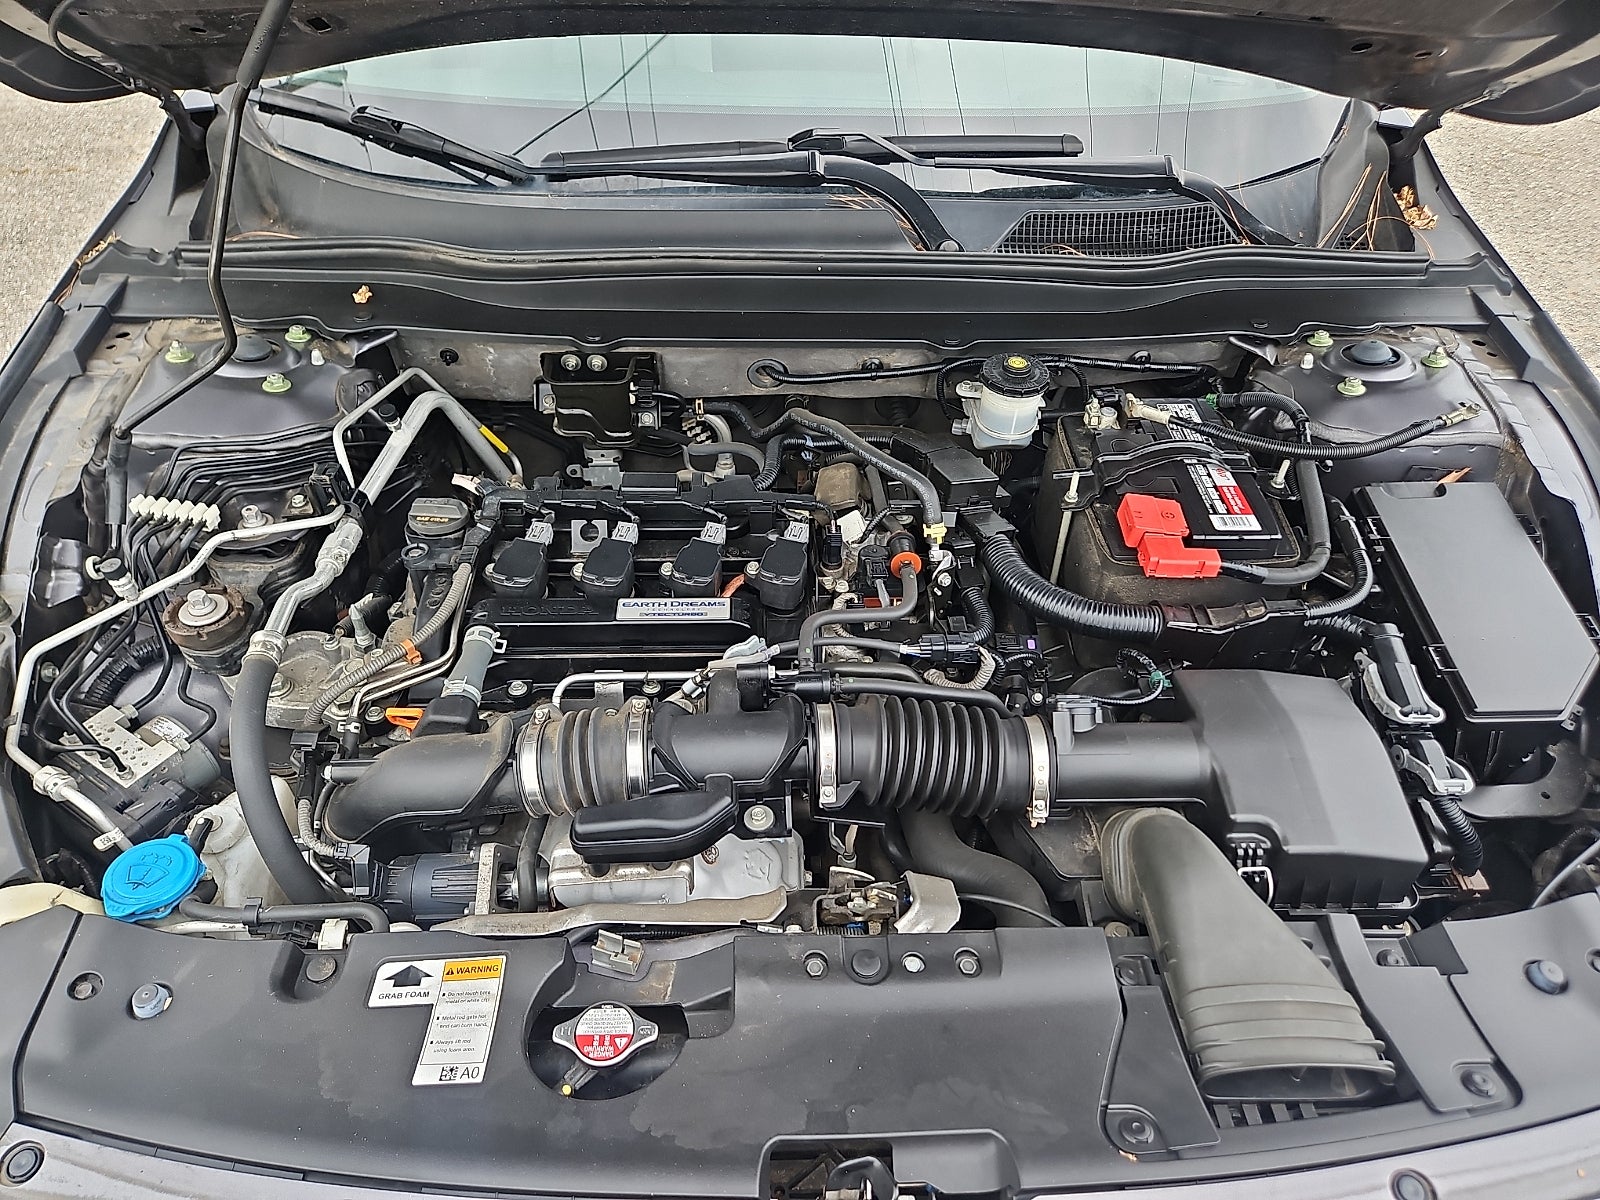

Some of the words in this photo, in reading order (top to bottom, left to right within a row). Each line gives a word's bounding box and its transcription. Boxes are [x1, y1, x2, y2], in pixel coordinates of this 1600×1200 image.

[500, 606, 599, 616] HONDA
[456, 964, 499, 974] WARNING
[378, 992, 403, 1000] GRAB
[405, 991, 430, 999] FOAM
